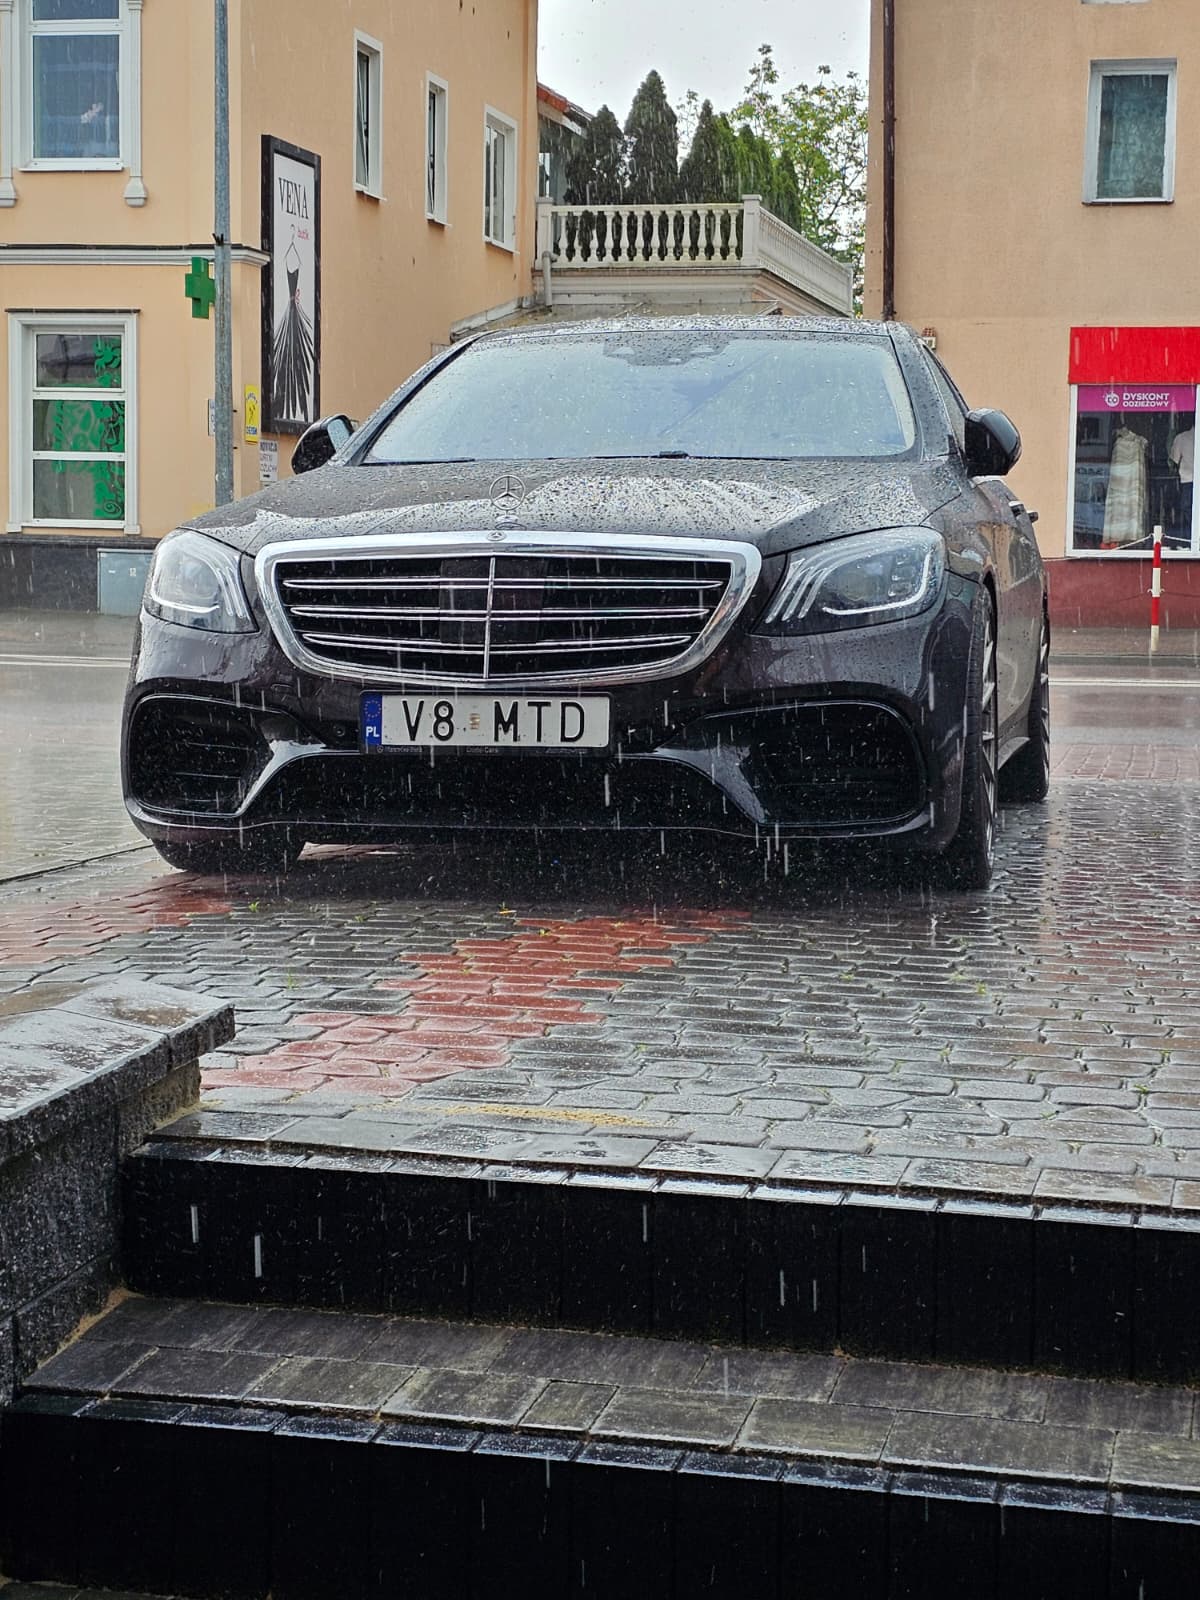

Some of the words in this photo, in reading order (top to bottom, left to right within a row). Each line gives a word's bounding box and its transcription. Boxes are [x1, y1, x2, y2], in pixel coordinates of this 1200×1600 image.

[278, 177, 309, 219] VENA
[1123, 393, 1170, 401] DYSKONT
[366, 727, 379, 738] PL
[402, 700, 454, 742] V8
[494, 701, 585, 743] MTD
